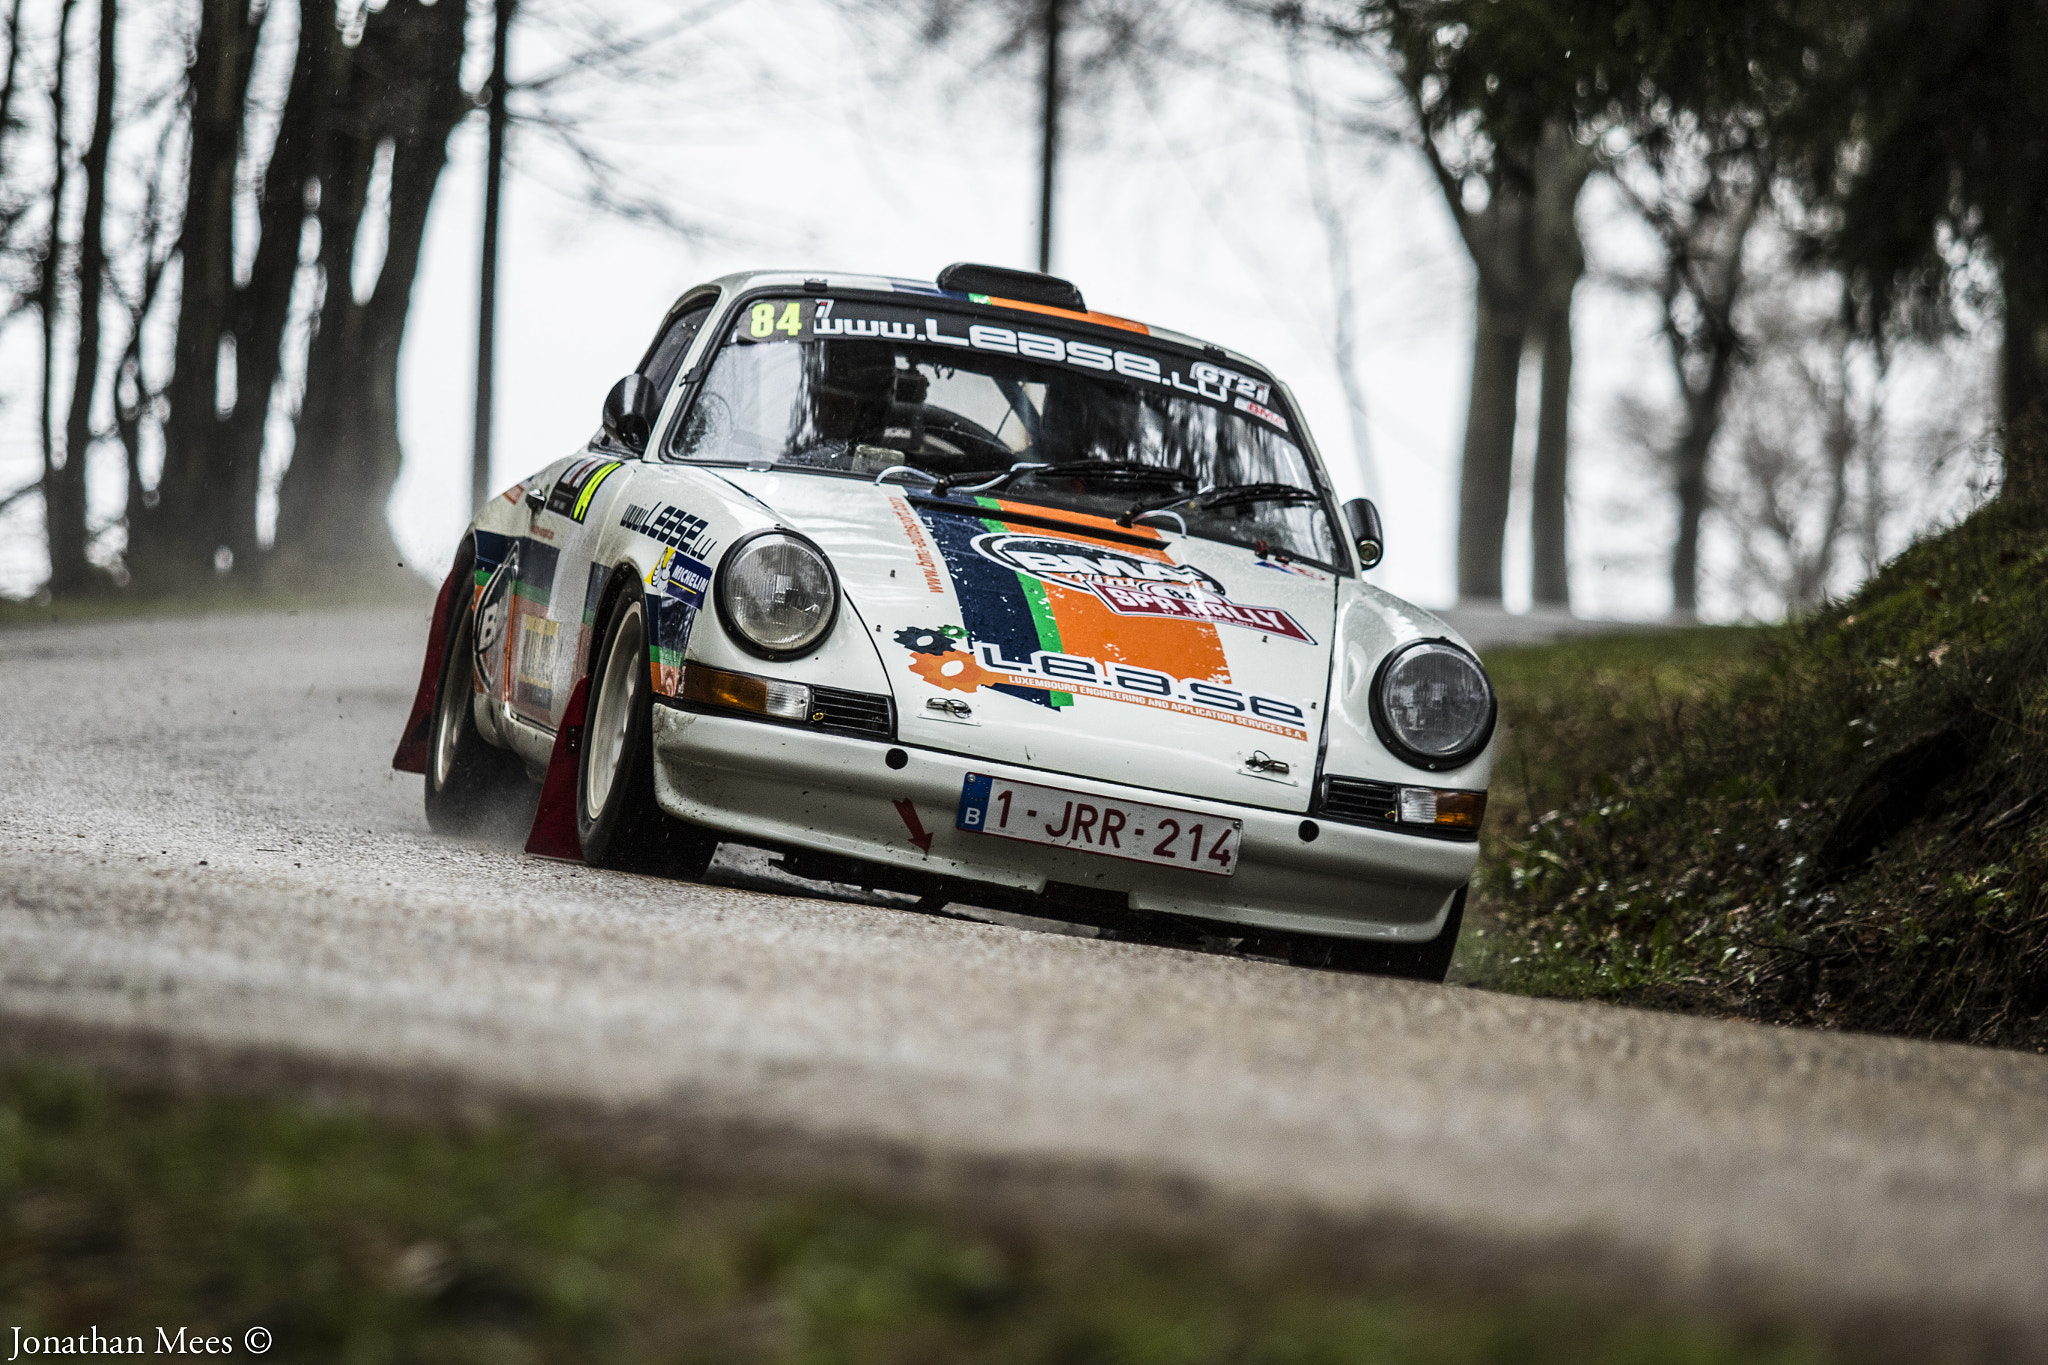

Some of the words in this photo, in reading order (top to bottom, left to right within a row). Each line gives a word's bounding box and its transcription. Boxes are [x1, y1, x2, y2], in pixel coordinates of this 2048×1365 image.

[750, 303, 802, 337] 84
[671, 565, 709, 593] MICHELIN
[1104, 587, 1181, 611] SPA
[1182, 601, 1286, 630] RALLY
[1008, 675, 1078, 693] LUXEMBOURG
[1079, 686, 1146, 706] ENGINEERING
[1147, 698, 1170, 709] AND
[1171, 703, 1234, 723] APPLICATION
[1236, 716, 1283, 734] SERVICES
[1285, 728, 1306, 740] S.A.
[964, 807, 981, 825] B
